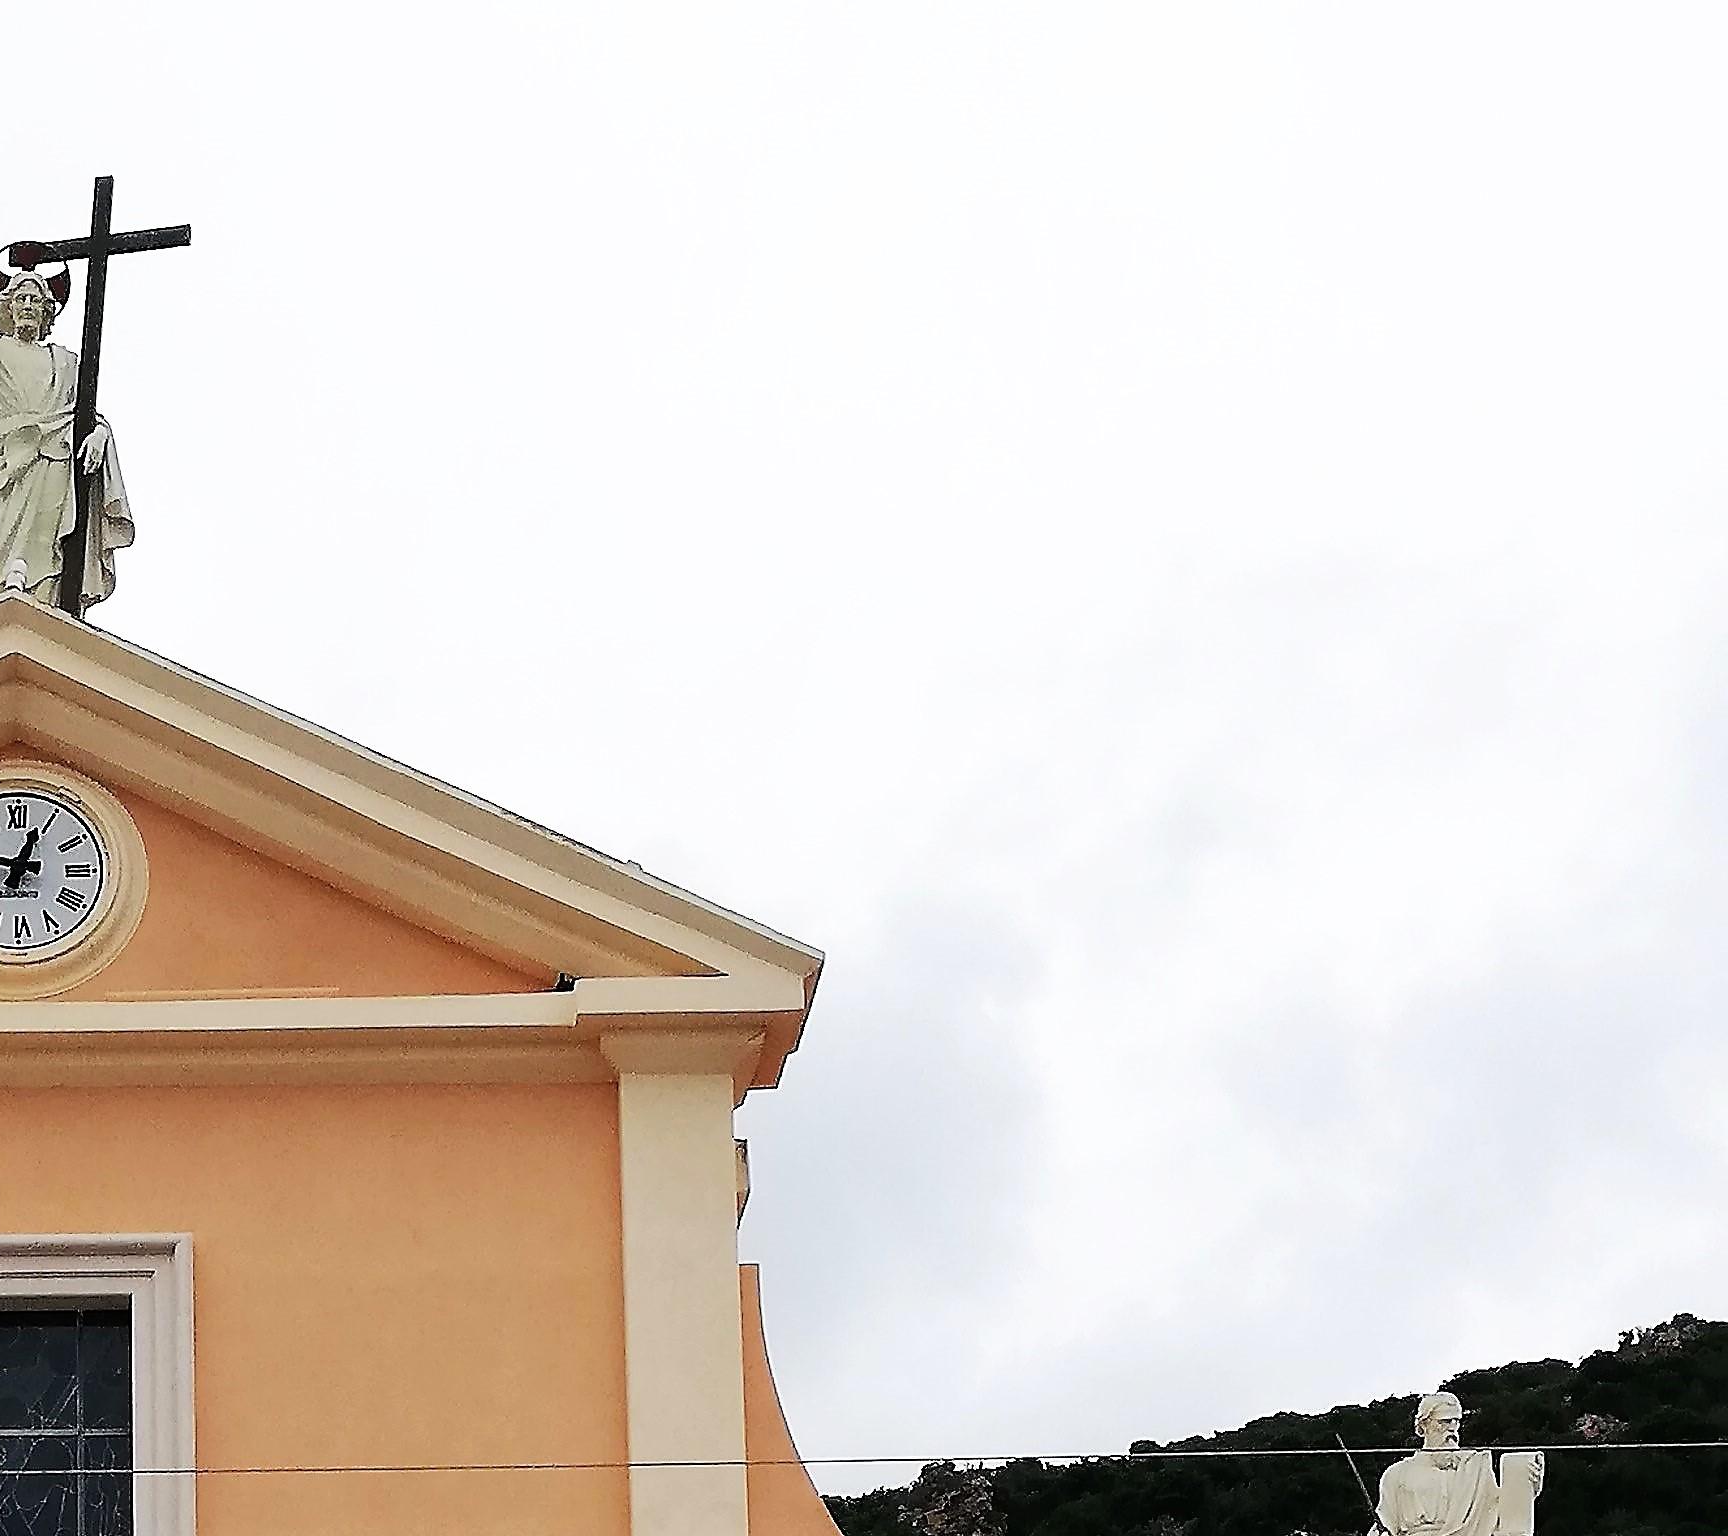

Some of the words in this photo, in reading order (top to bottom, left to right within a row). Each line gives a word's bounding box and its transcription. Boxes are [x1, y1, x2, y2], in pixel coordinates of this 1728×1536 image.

[7, 804, 28, 829] XII
[57, 835, 83, 853] II
[65, 863, 91, 878] III
[55, 886, 86, 912] IIII
[14, 915, 32, 938] VI
[42, 909, 59, 933] V
